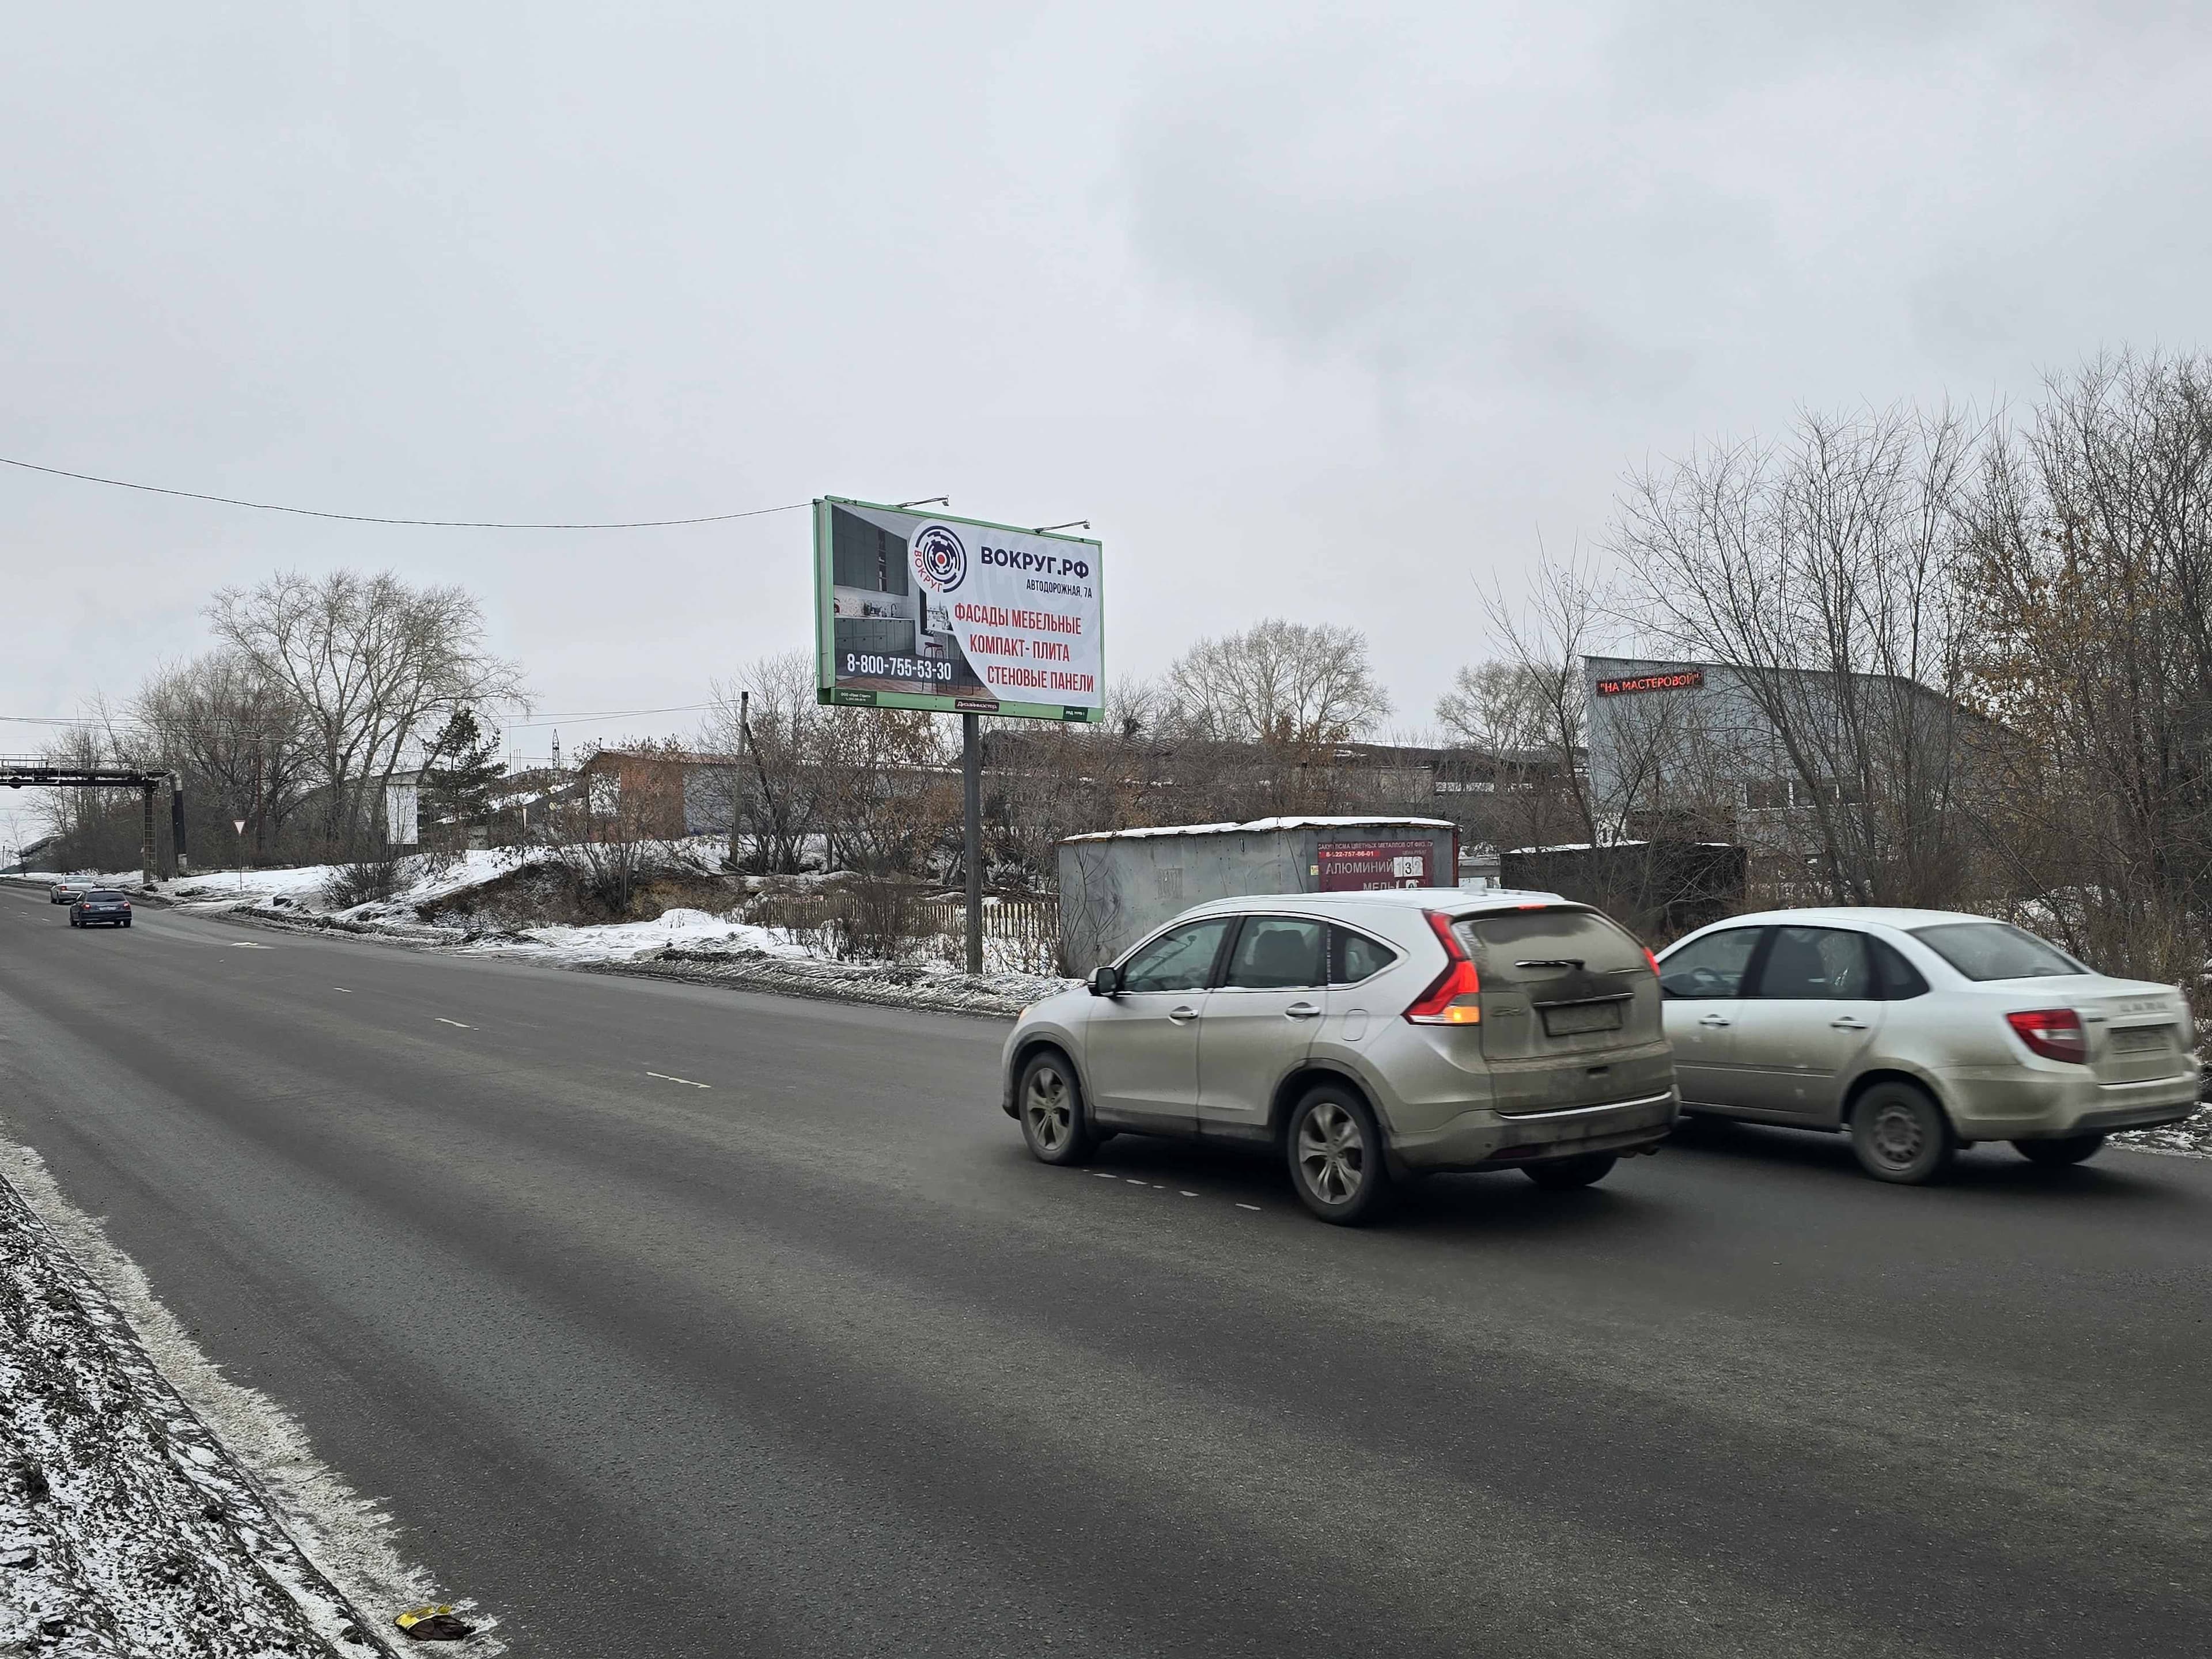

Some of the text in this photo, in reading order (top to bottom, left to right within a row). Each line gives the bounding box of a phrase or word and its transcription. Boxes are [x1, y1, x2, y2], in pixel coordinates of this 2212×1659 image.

[914, 550, 942, 592] ВОКРУГ
[981, 546, 1089, 579] ВОКРУГ.РФ
[1027, 579, 1092, 599] АВТОДОРОЖНАЯ, 7А
[955, 603, 1082, 635] ФАСАДЫ МЕБЕЛЬНЫЕ
[970, 634, 1070, 662] КОМПАКТ- ПЛИТА
[847, 653, 952, 680] 8-800-755-53-30
[987, 665, 1094, 692] СТЕНОВЫЕ ПАНЕЛИ
[1600, 673, 1699, 692] "НА МАСТЕРОВОЙ"
[1326, 859, 1393, 874] АЛЮМИНИЙ
